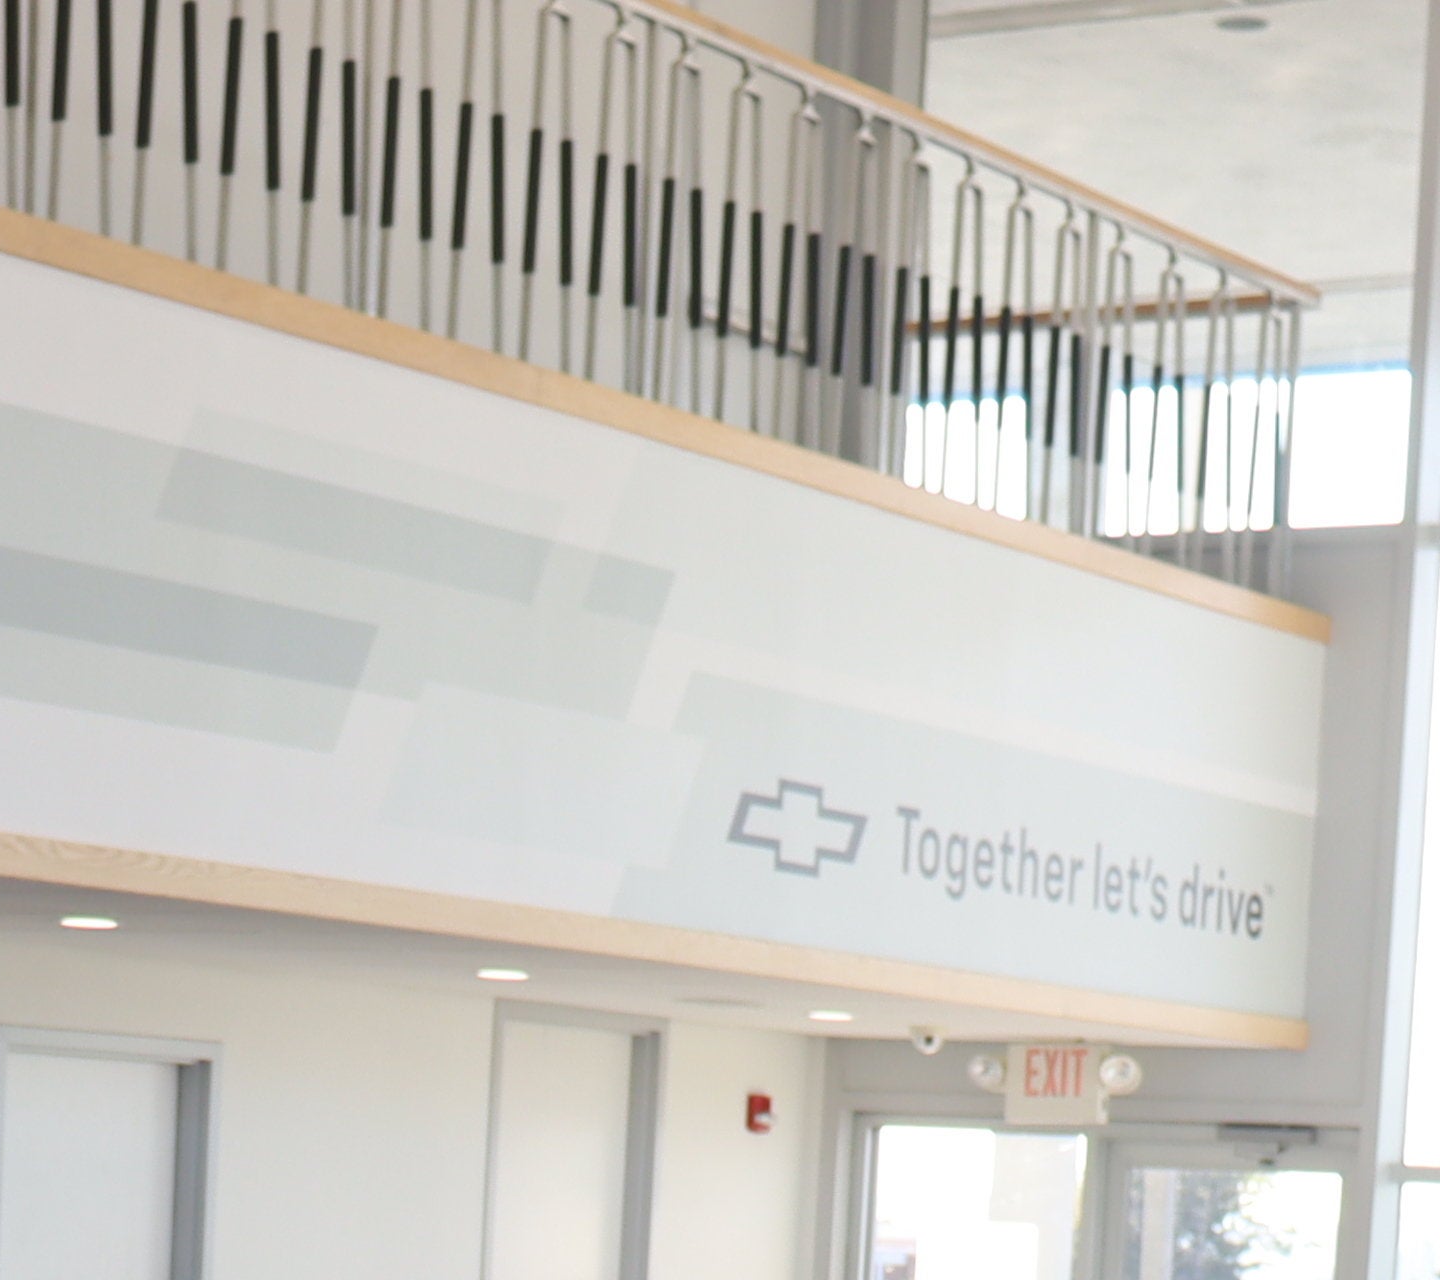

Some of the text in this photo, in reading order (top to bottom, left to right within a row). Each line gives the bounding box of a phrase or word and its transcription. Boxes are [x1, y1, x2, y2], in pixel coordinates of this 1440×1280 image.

[896, 806, 1084, 901] Together
[1093, 842, 1168, 922] let's
[1025, 1047, 1088, 1097] EXIT
